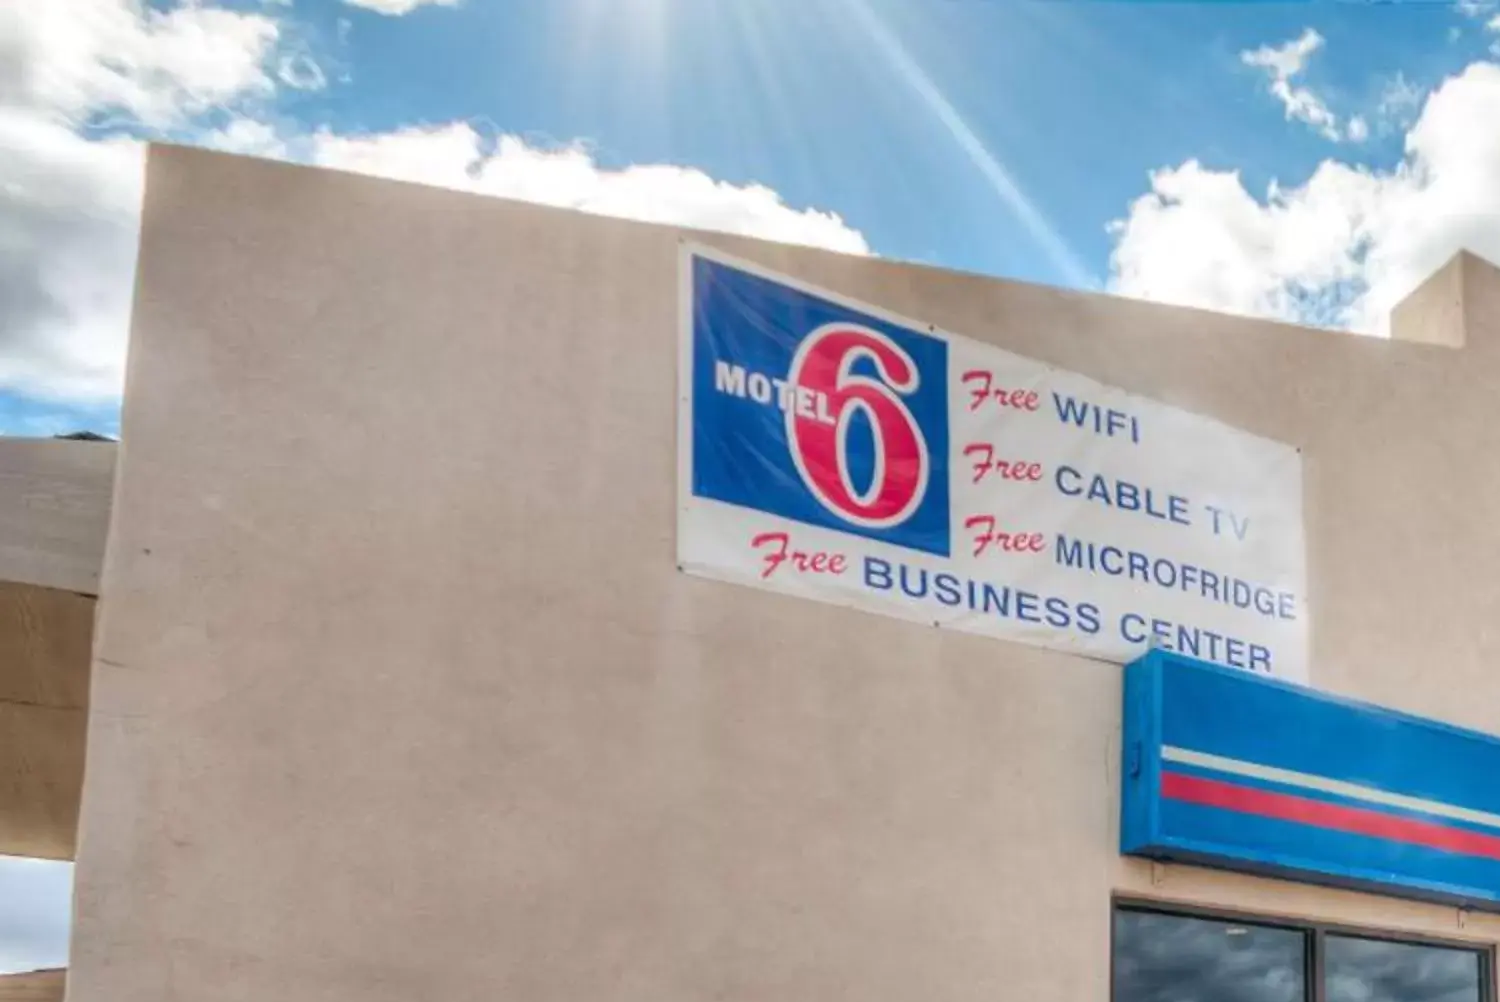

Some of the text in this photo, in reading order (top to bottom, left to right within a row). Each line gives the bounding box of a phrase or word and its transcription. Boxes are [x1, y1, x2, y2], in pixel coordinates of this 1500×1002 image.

[715, 321, 929, 529] MOTEL 6
[961, 370, 1141, 444] Free WIFI
[963, 443, 1252, 543] Free CABLE TV
[751, 532, 1272, 673] Free BUSINESS CENTER
[964, 516, 1297, 621] Free MICROFRIDGE
